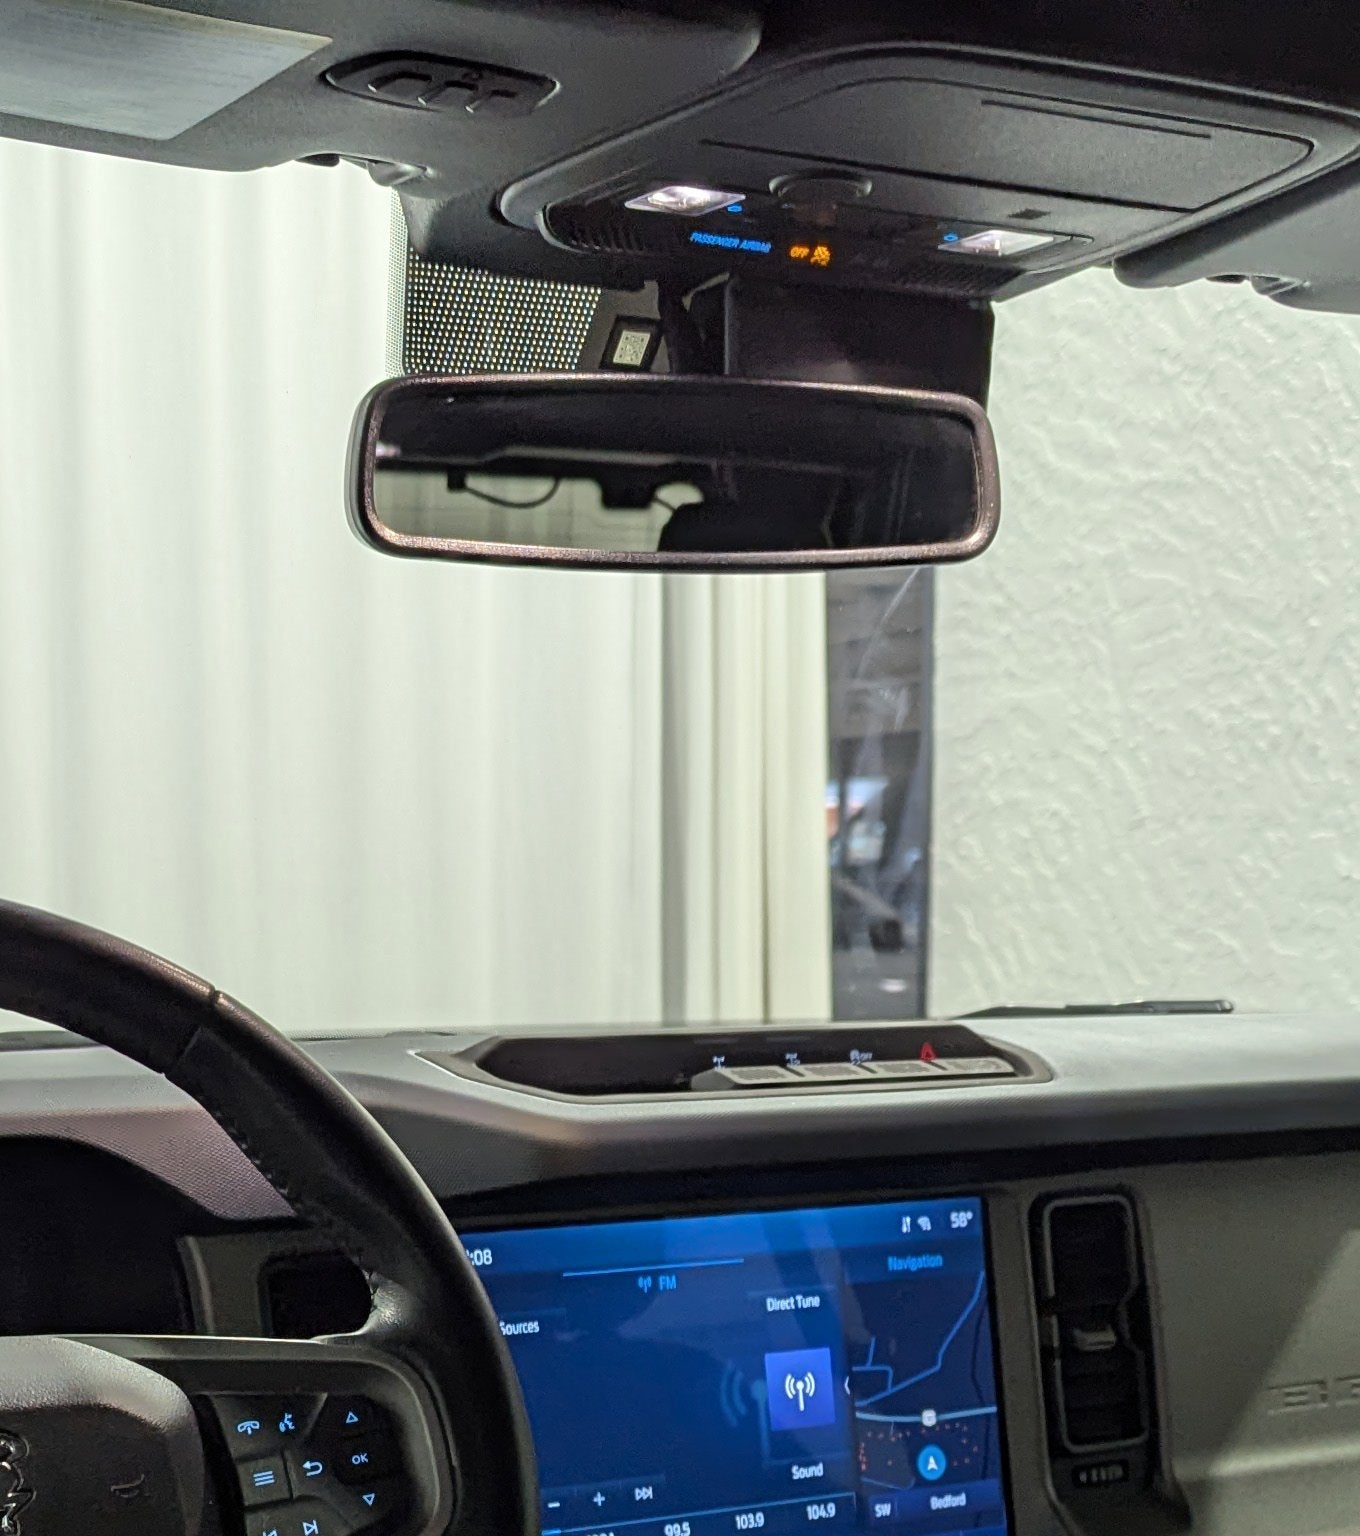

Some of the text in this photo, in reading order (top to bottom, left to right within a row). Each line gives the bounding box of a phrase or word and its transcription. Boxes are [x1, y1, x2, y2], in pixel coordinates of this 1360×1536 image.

[888, 1254, 943, 1271] Navigation
[659, 1275, 677, 1291] FM
[766, 1294, 821, 1312] Direct Tune
[499, 1320, 539, 1336] Sources
[351, 1452, 369, 1465] OK
[792, 1463, 824, 1480] Sound
[930, 1492, 967, 1511] Bedford
[807, 1502, 836, 1521] 104.9
[875, 1503, 891, 1518] SW
[735, 1512, 765, 1530] 103.9
